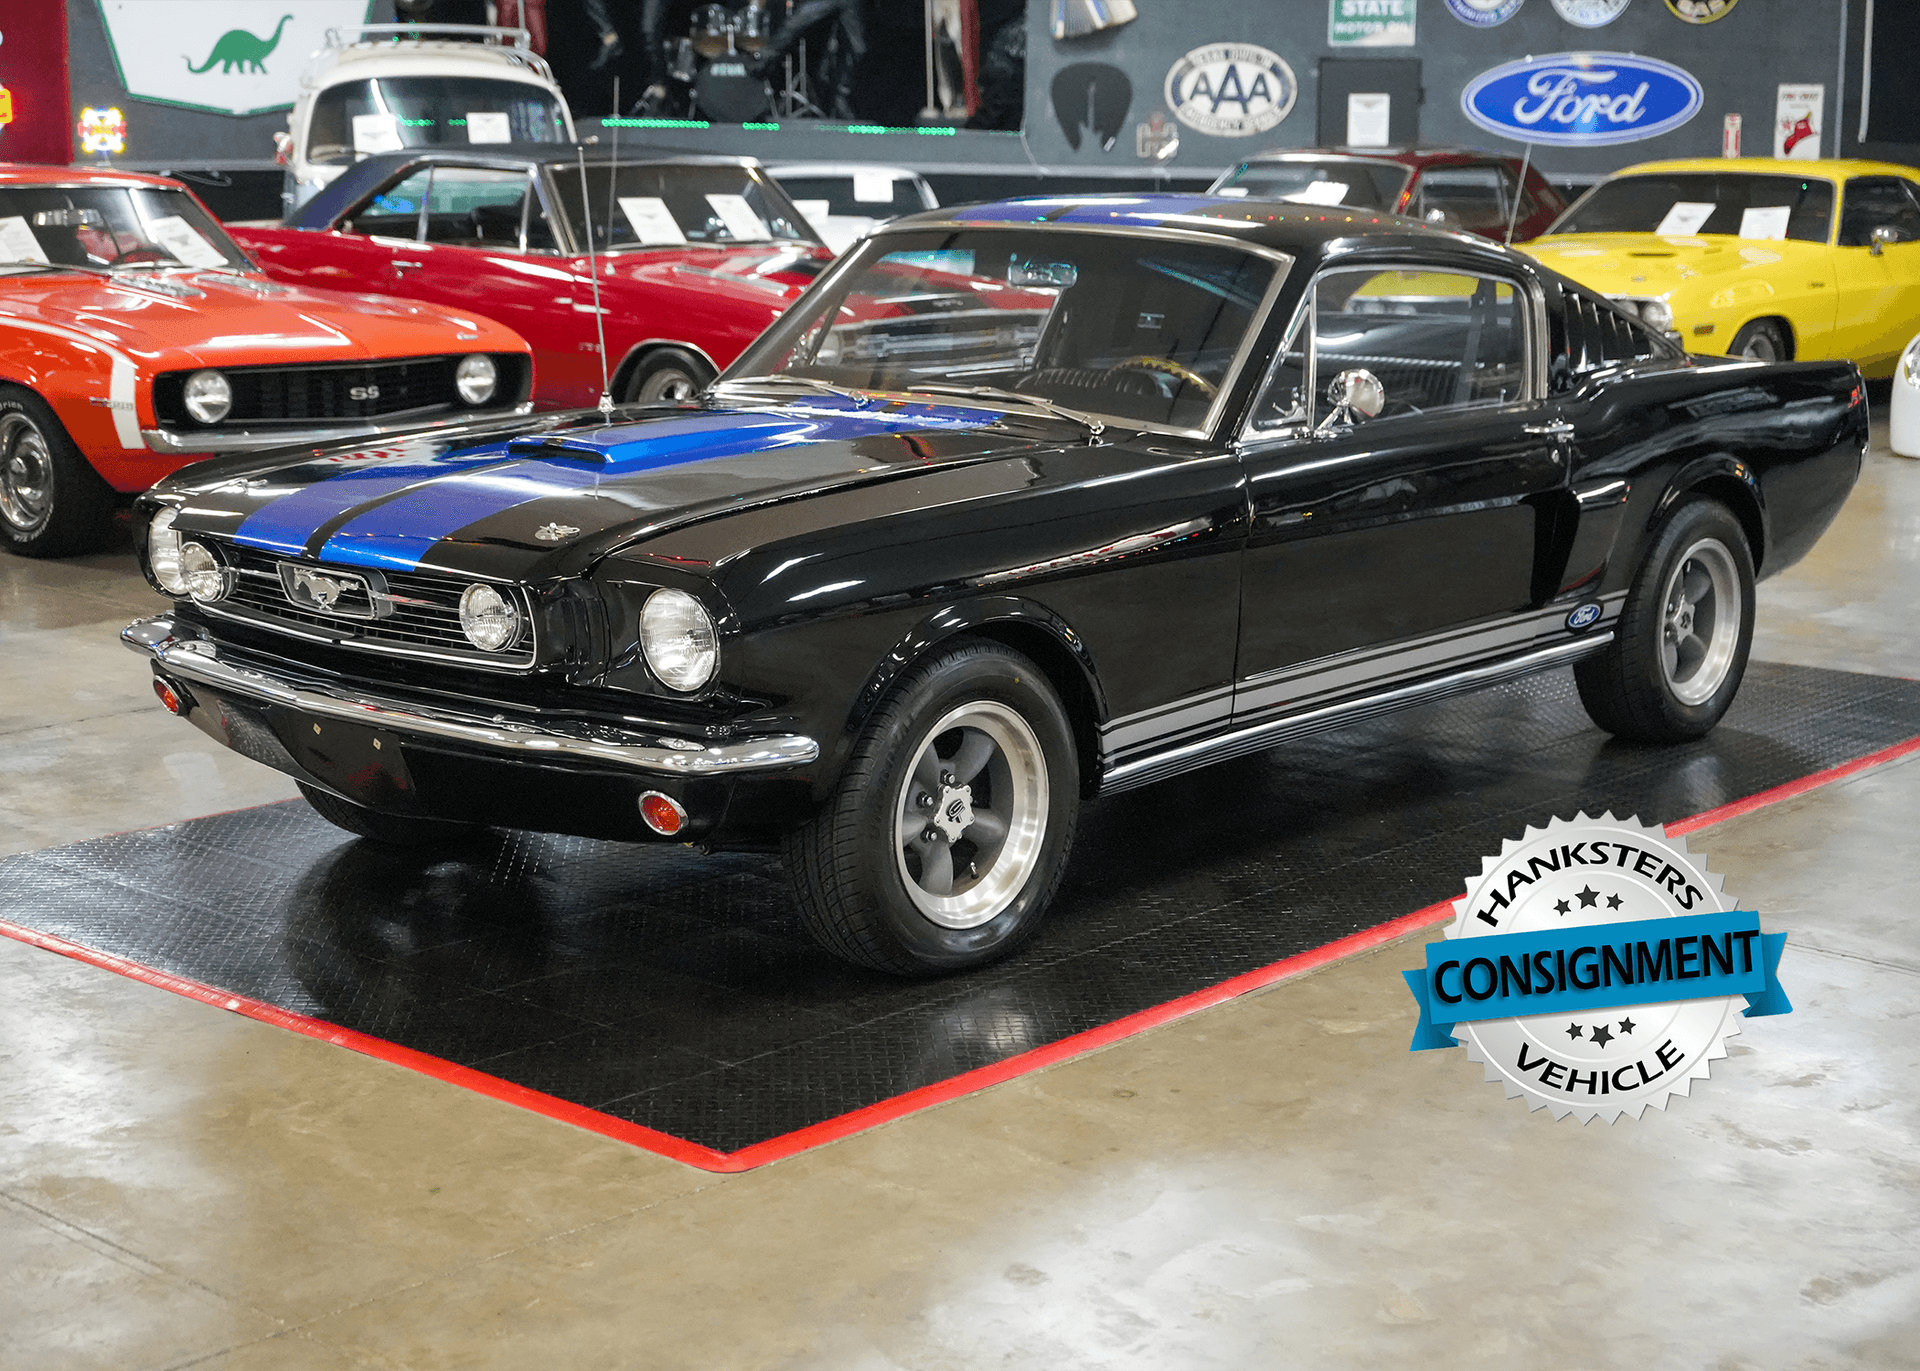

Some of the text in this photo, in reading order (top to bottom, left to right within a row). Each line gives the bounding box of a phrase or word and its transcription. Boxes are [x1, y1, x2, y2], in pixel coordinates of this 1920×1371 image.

[1342, 0, 1404, 16] STATE
[1190, 64, 1271, 114] AAA
[1513, 68, 1650, 124] Ford
[350, 385, 380, 400] SS
[1573, 606, 1596, 625] Ford
